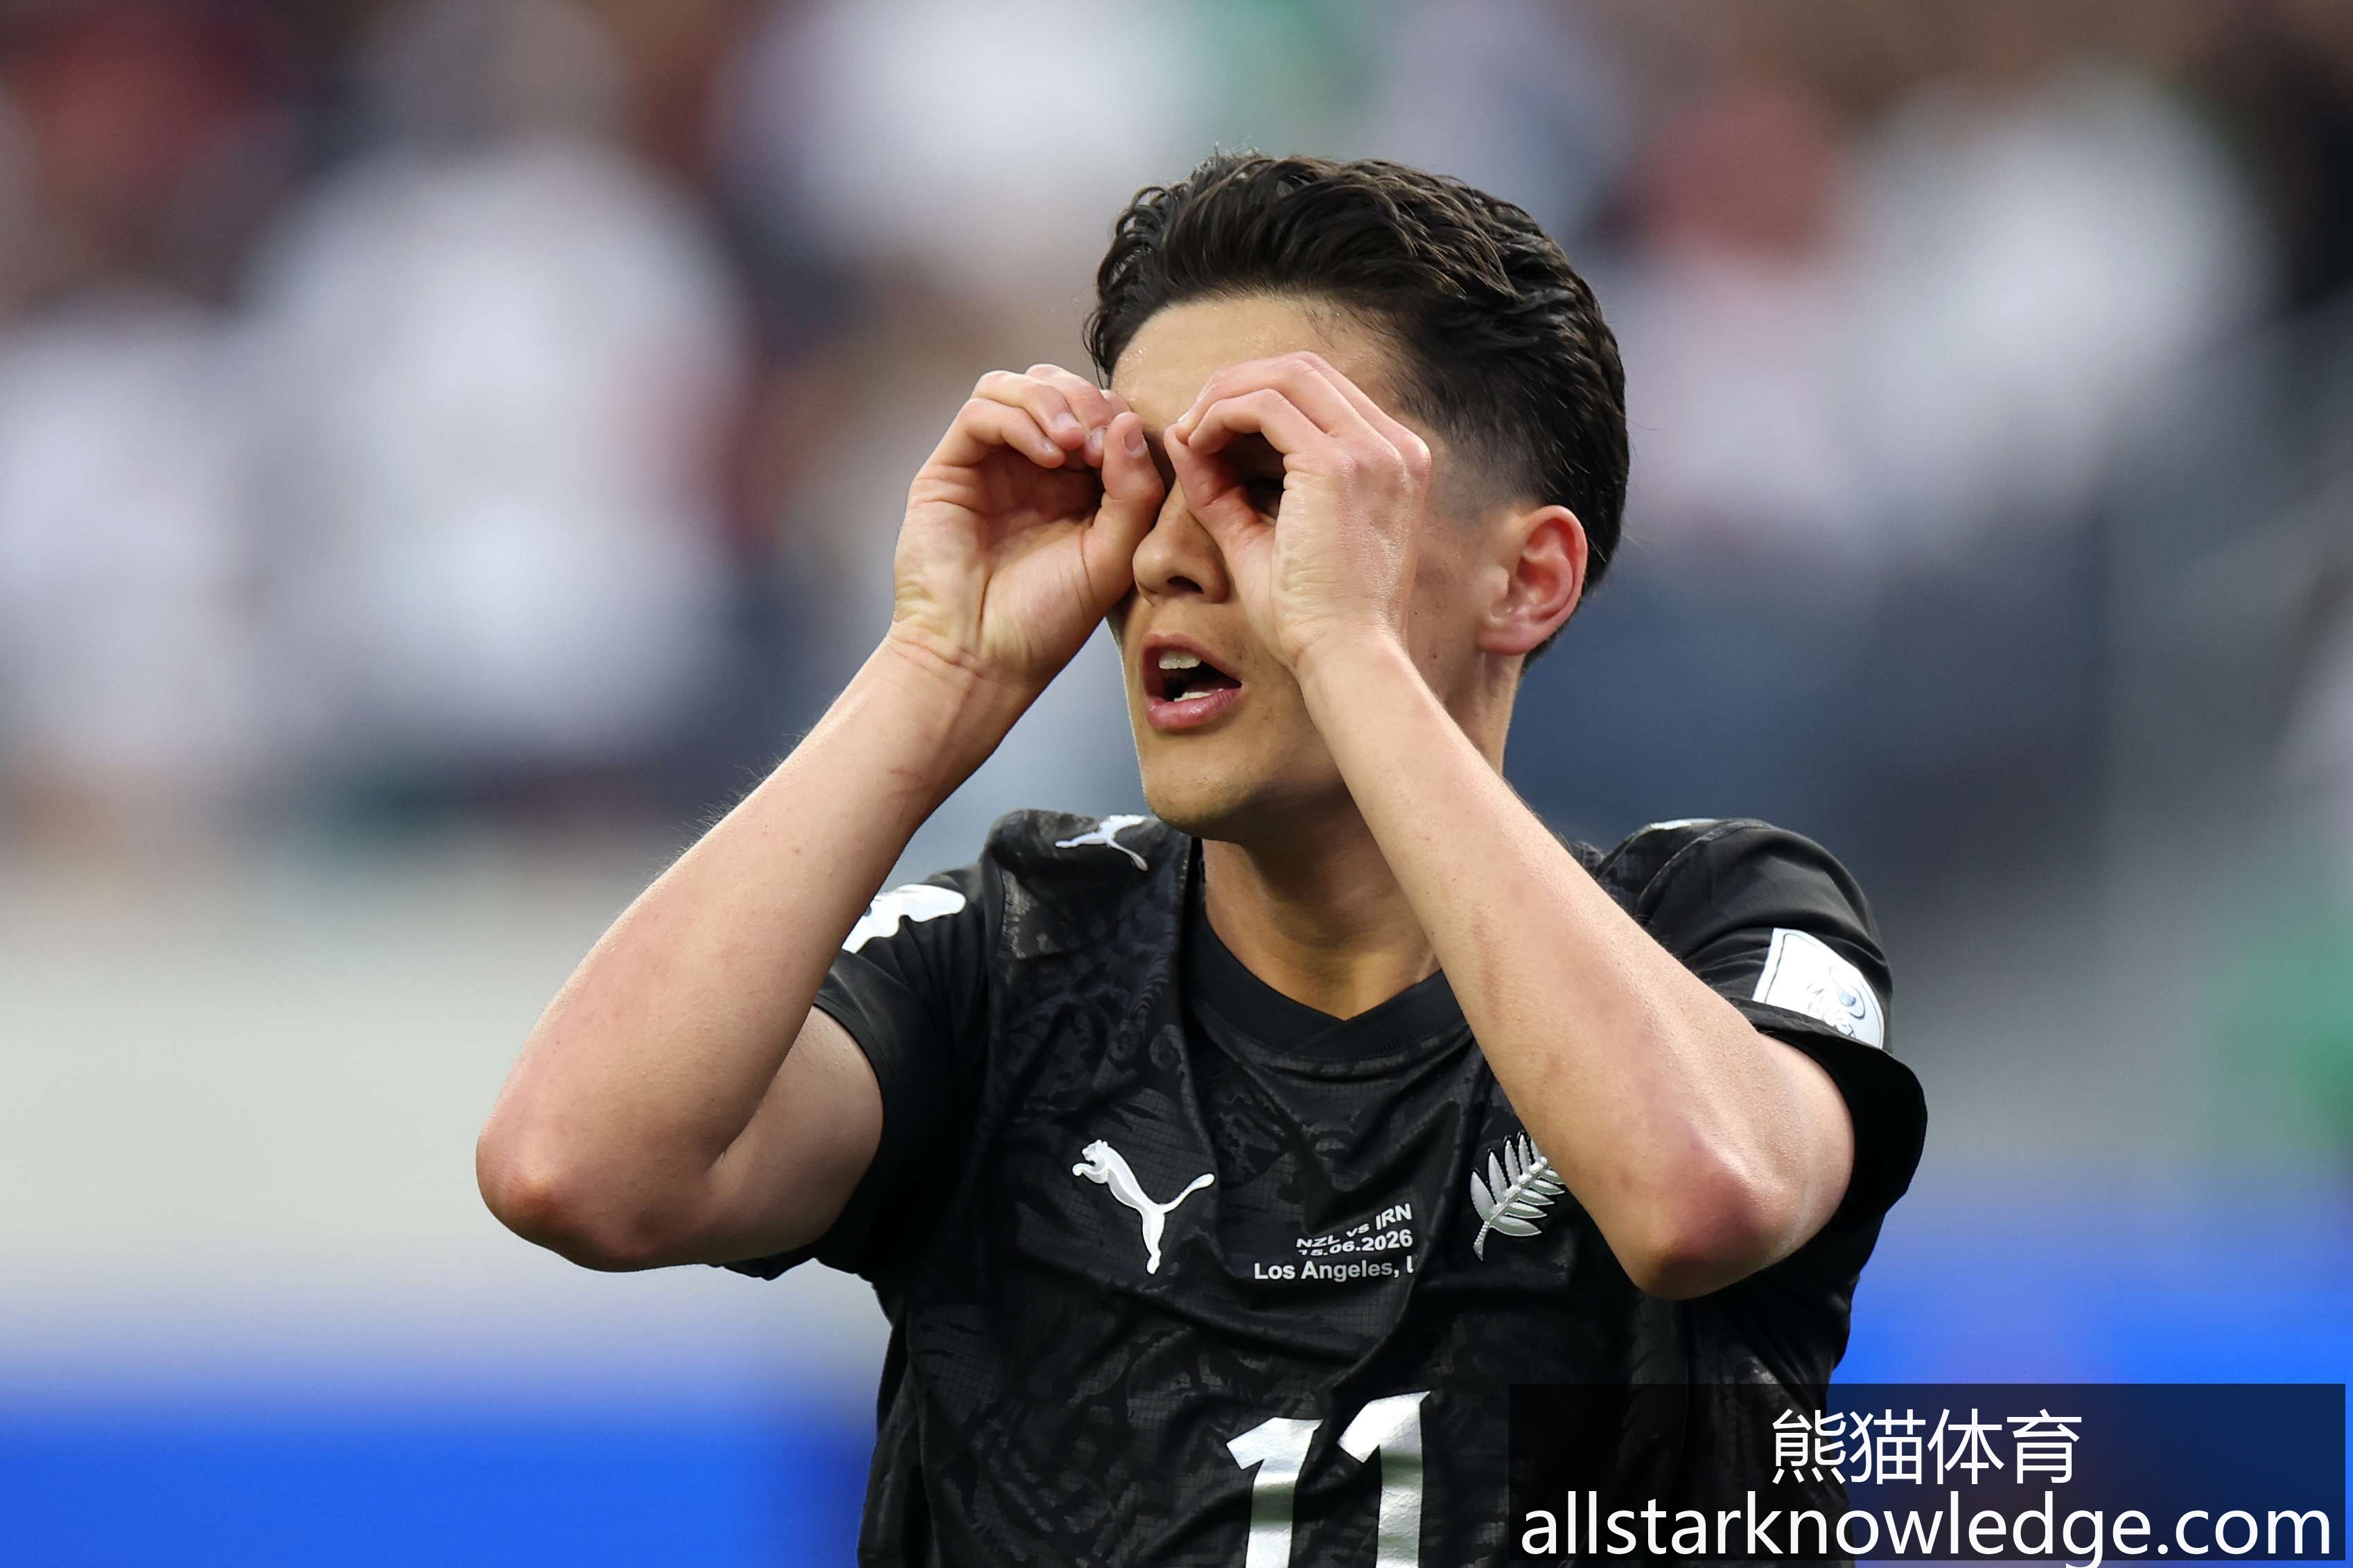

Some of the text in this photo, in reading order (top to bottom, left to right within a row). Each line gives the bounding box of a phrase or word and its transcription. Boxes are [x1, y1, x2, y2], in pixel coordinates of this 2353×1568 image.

[1296, 1203, 1412, 1248] NZL vs IRN
[1298, 1229, 1413, 1256] 15.06.2026
[1254, 1262, 1296, 1280] Los
[1301, 1260, 1399, 1282] Angeles,
[1226, 1391, 1431, 1568] 11
